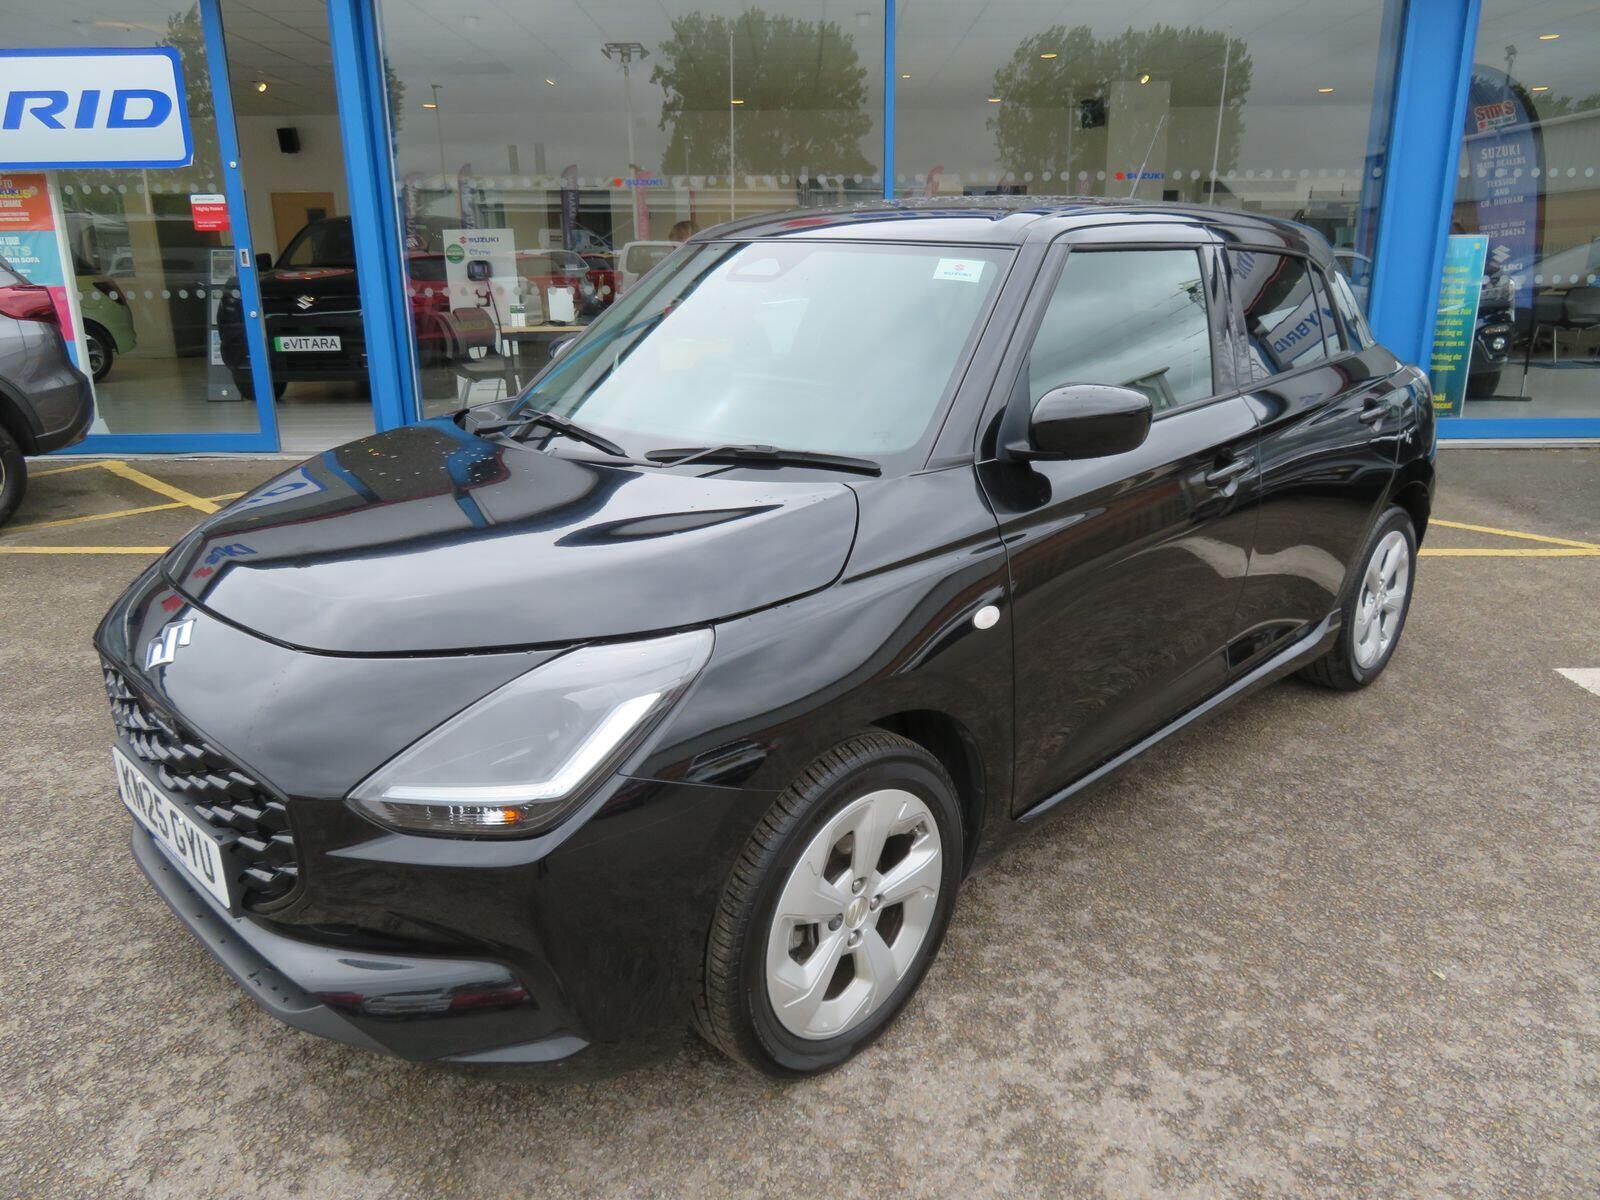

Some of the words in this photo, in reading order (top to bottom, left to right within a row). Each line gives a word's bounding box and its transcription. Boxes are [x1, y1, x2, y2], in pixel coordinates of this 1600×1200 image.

[3, 89, 172, 129] RID
[1481, 144, 1520, 160] SUZUKI
[625, 178, 664, 187] SUZUKI
[283, 338, 338, 349] eVITARA
[119, 758, 169, 839] KN25
[170, 809, 216, 884] GYU
